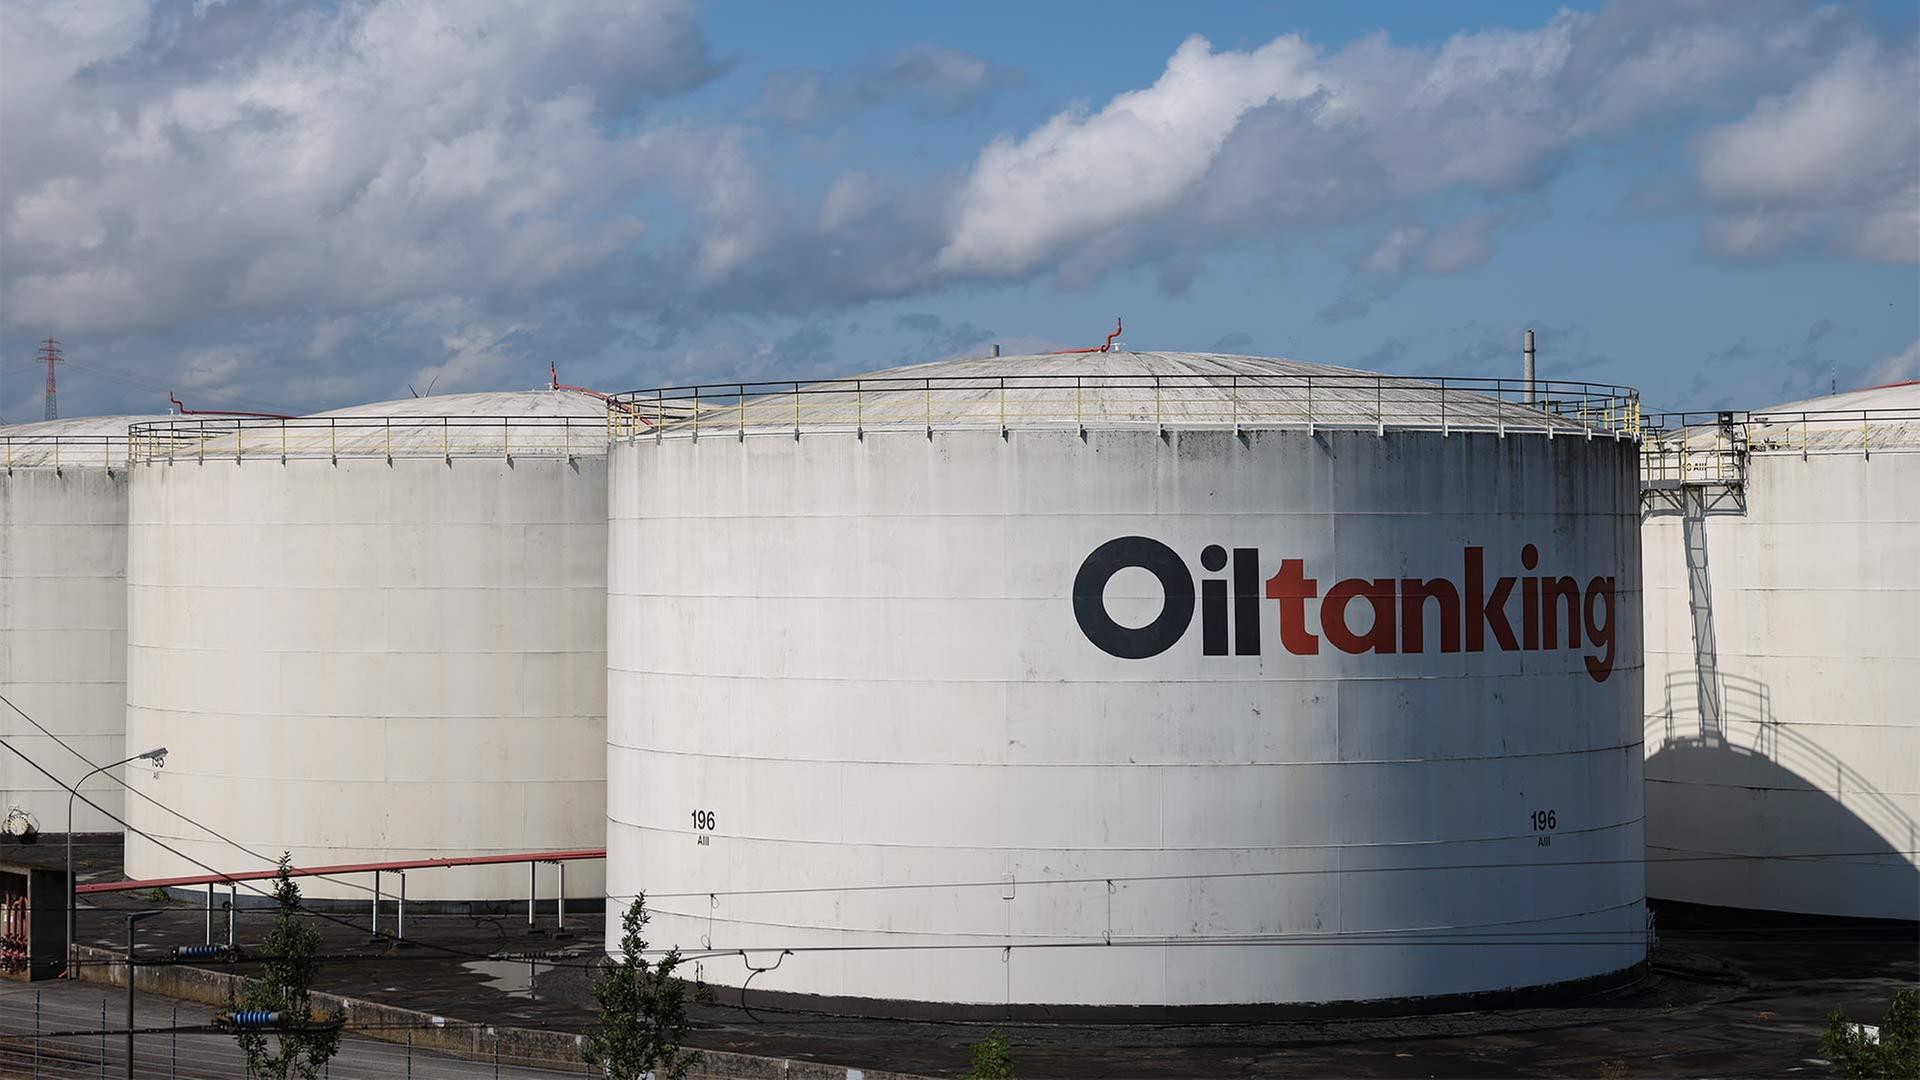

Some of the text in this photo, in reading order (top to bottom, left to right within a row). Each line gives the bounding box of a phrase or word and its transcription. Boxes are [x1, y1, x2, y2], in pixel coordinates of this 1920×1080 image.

[1072, 535, 1616, 683] Oiltanking
[691, 809, 715, 831] 196
[1530, 809, 1557, 831] 196
